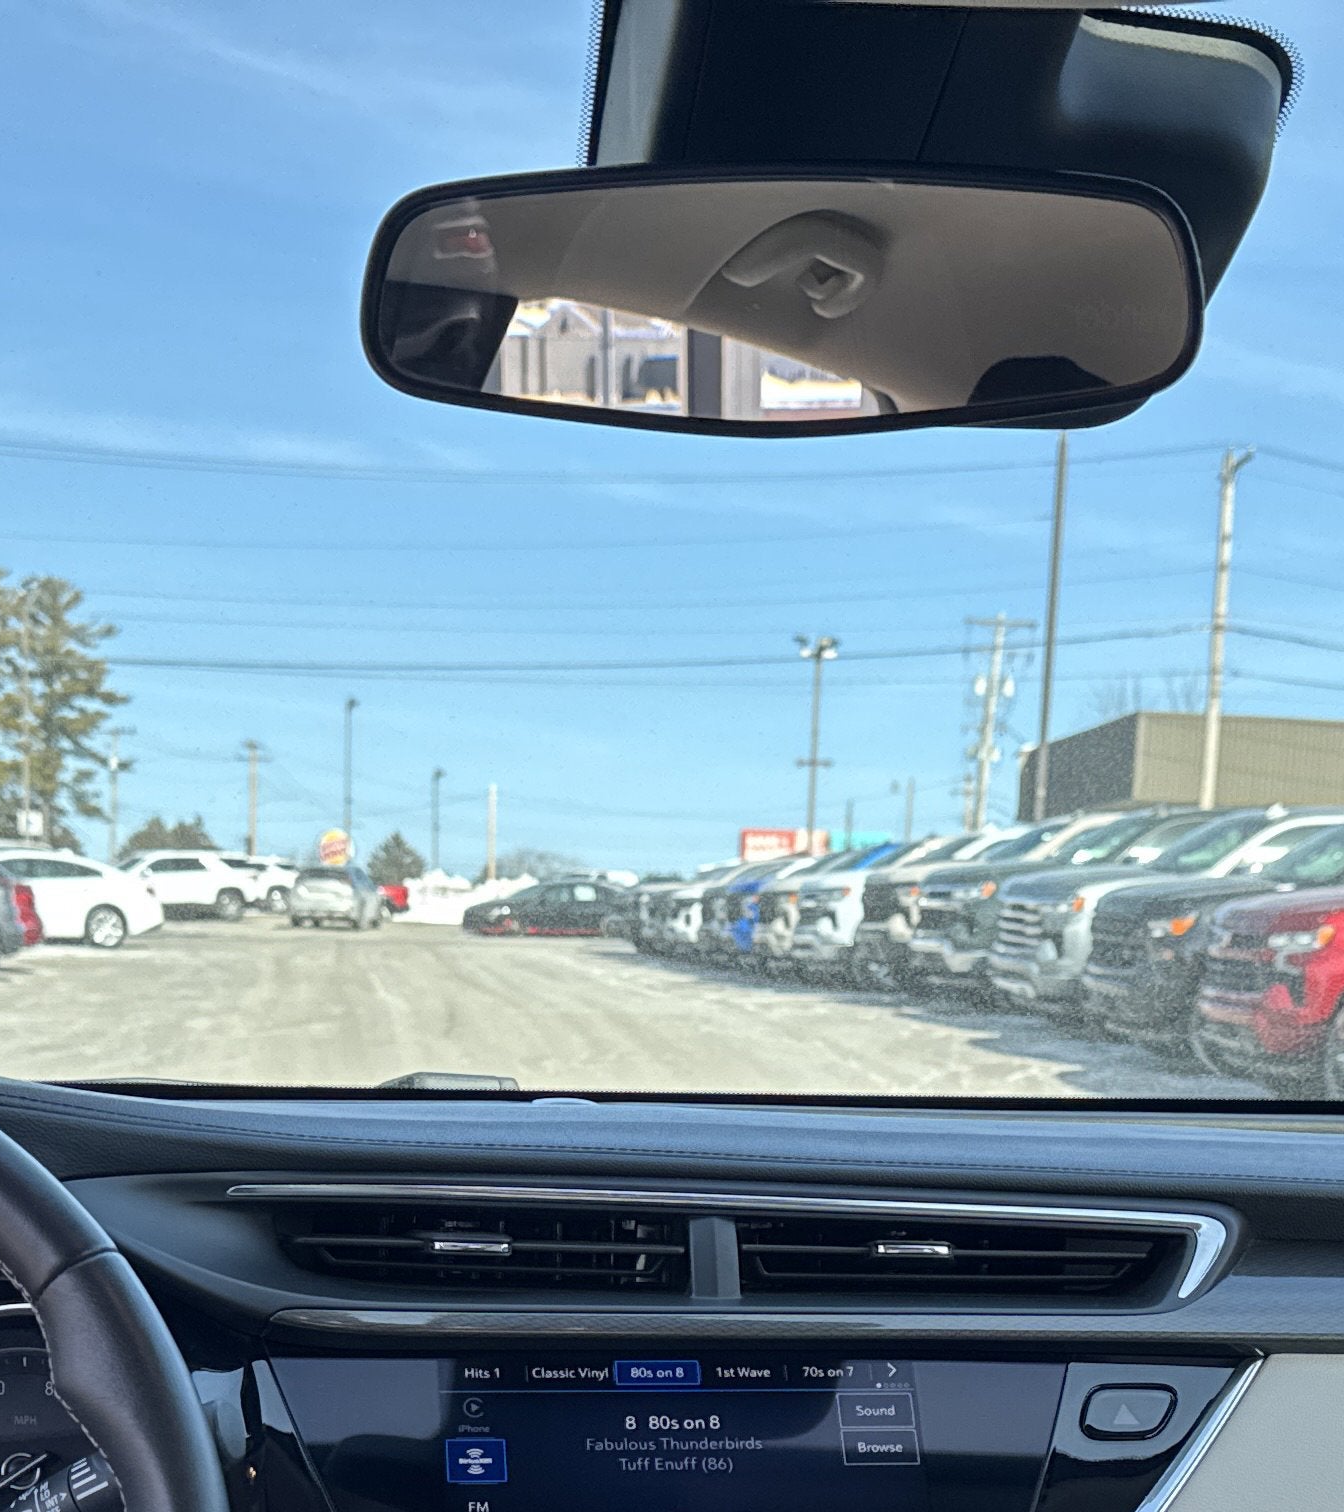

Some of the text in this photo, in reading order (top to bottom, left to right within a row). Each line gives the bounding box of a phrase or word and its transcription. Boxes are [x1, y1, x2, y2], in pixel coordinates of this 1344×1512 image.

[464, 1367, 501, 1379] Hits 1
[531, 1367, 609, 1382] Classic Vinyl
[630, 1367, 685, 1379] 80s on 8
[716, 1367, 771, 1379] 1st Wave
[802, 1366, 854, 1378] 70s on 7
[856, 1405, 896, 1417] Sound
[14, 1415, 37, 1425] MPH
[625, 1415, 721, 1430] 8 80s on 8
[458, 1424, 491, 1433] iPhone
[586, 1436, 763, 1451] Fabulous Thunderbirds
[857, 1441, 904, 1453] Browse
[619, 1456, 734, 1473] Tuff Enuff (86)
[45, 1494, 58, 1509] INT
[468, 1501, 490, 1512] FM
